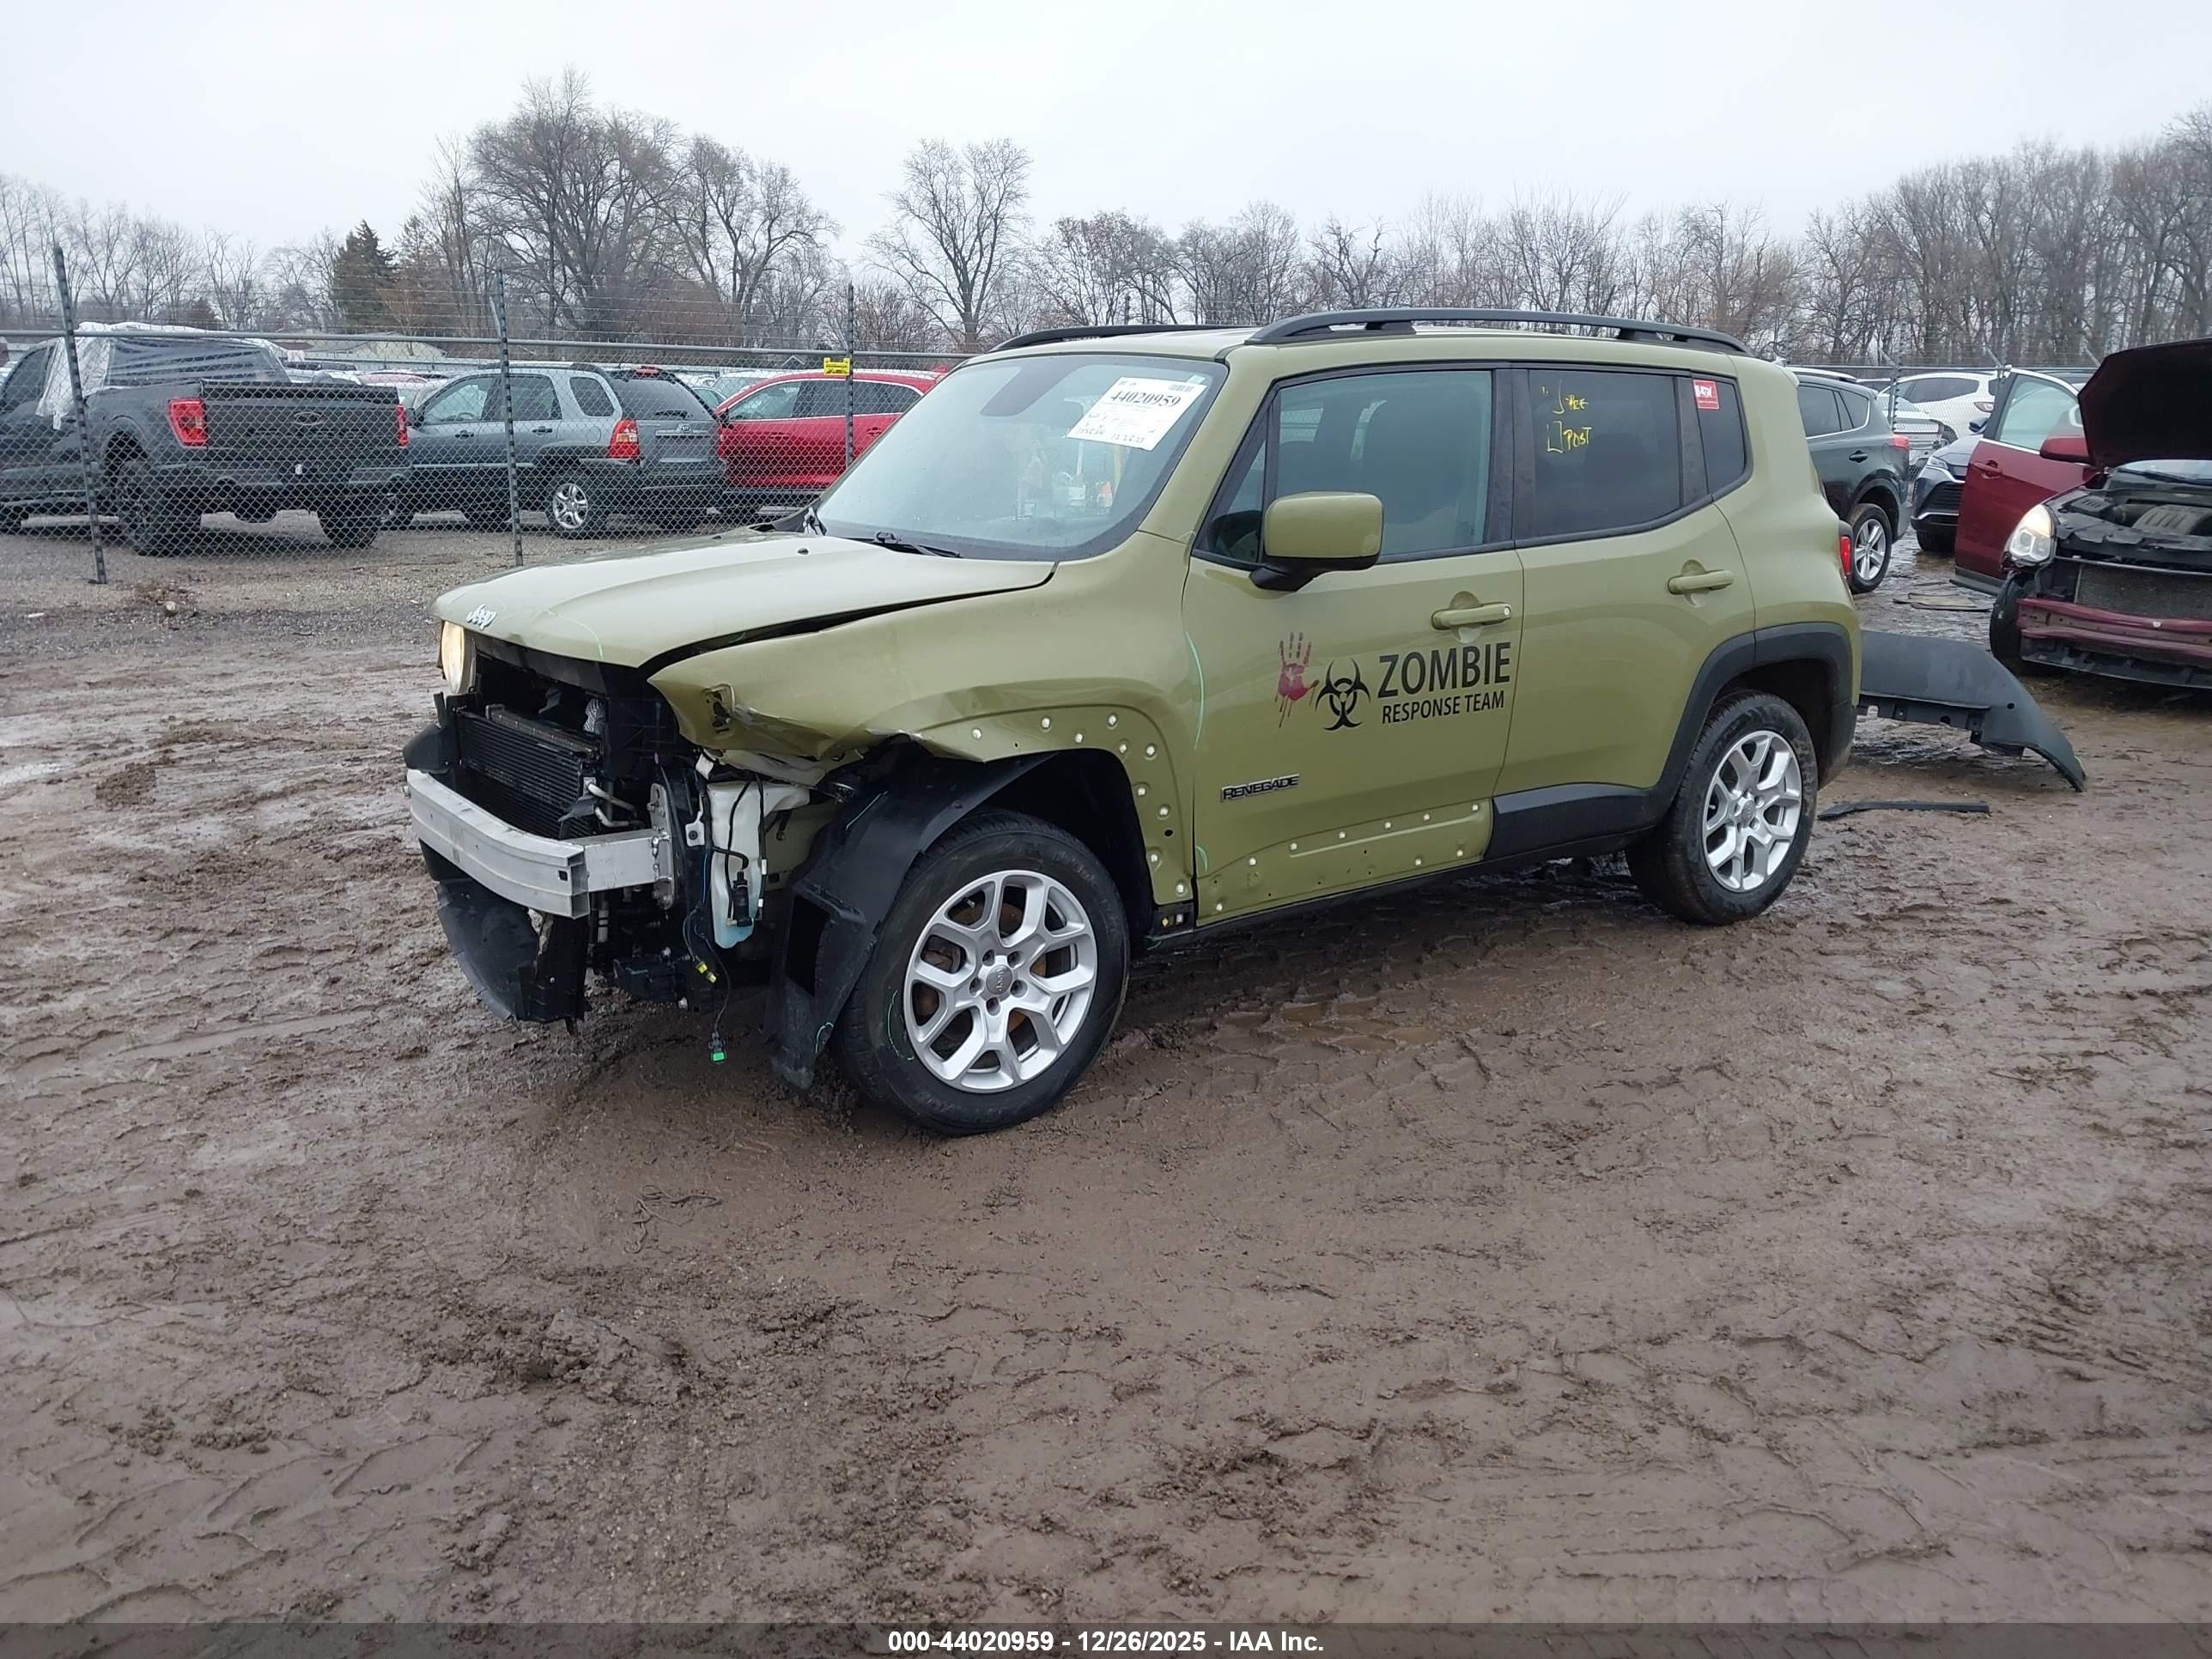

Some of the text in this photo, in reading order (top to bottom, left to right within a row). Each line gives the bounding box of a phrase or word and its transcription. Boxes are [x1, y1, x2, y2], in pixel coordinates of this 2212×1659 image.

[1110, 390, 1182, 408] 44020959
[1377, 641, 1511, 699] ZOMBIE
[1382, 690, 1505, 725] RESPONSE TEAM
[1221, 774, 1300, 801] RENEGADE
